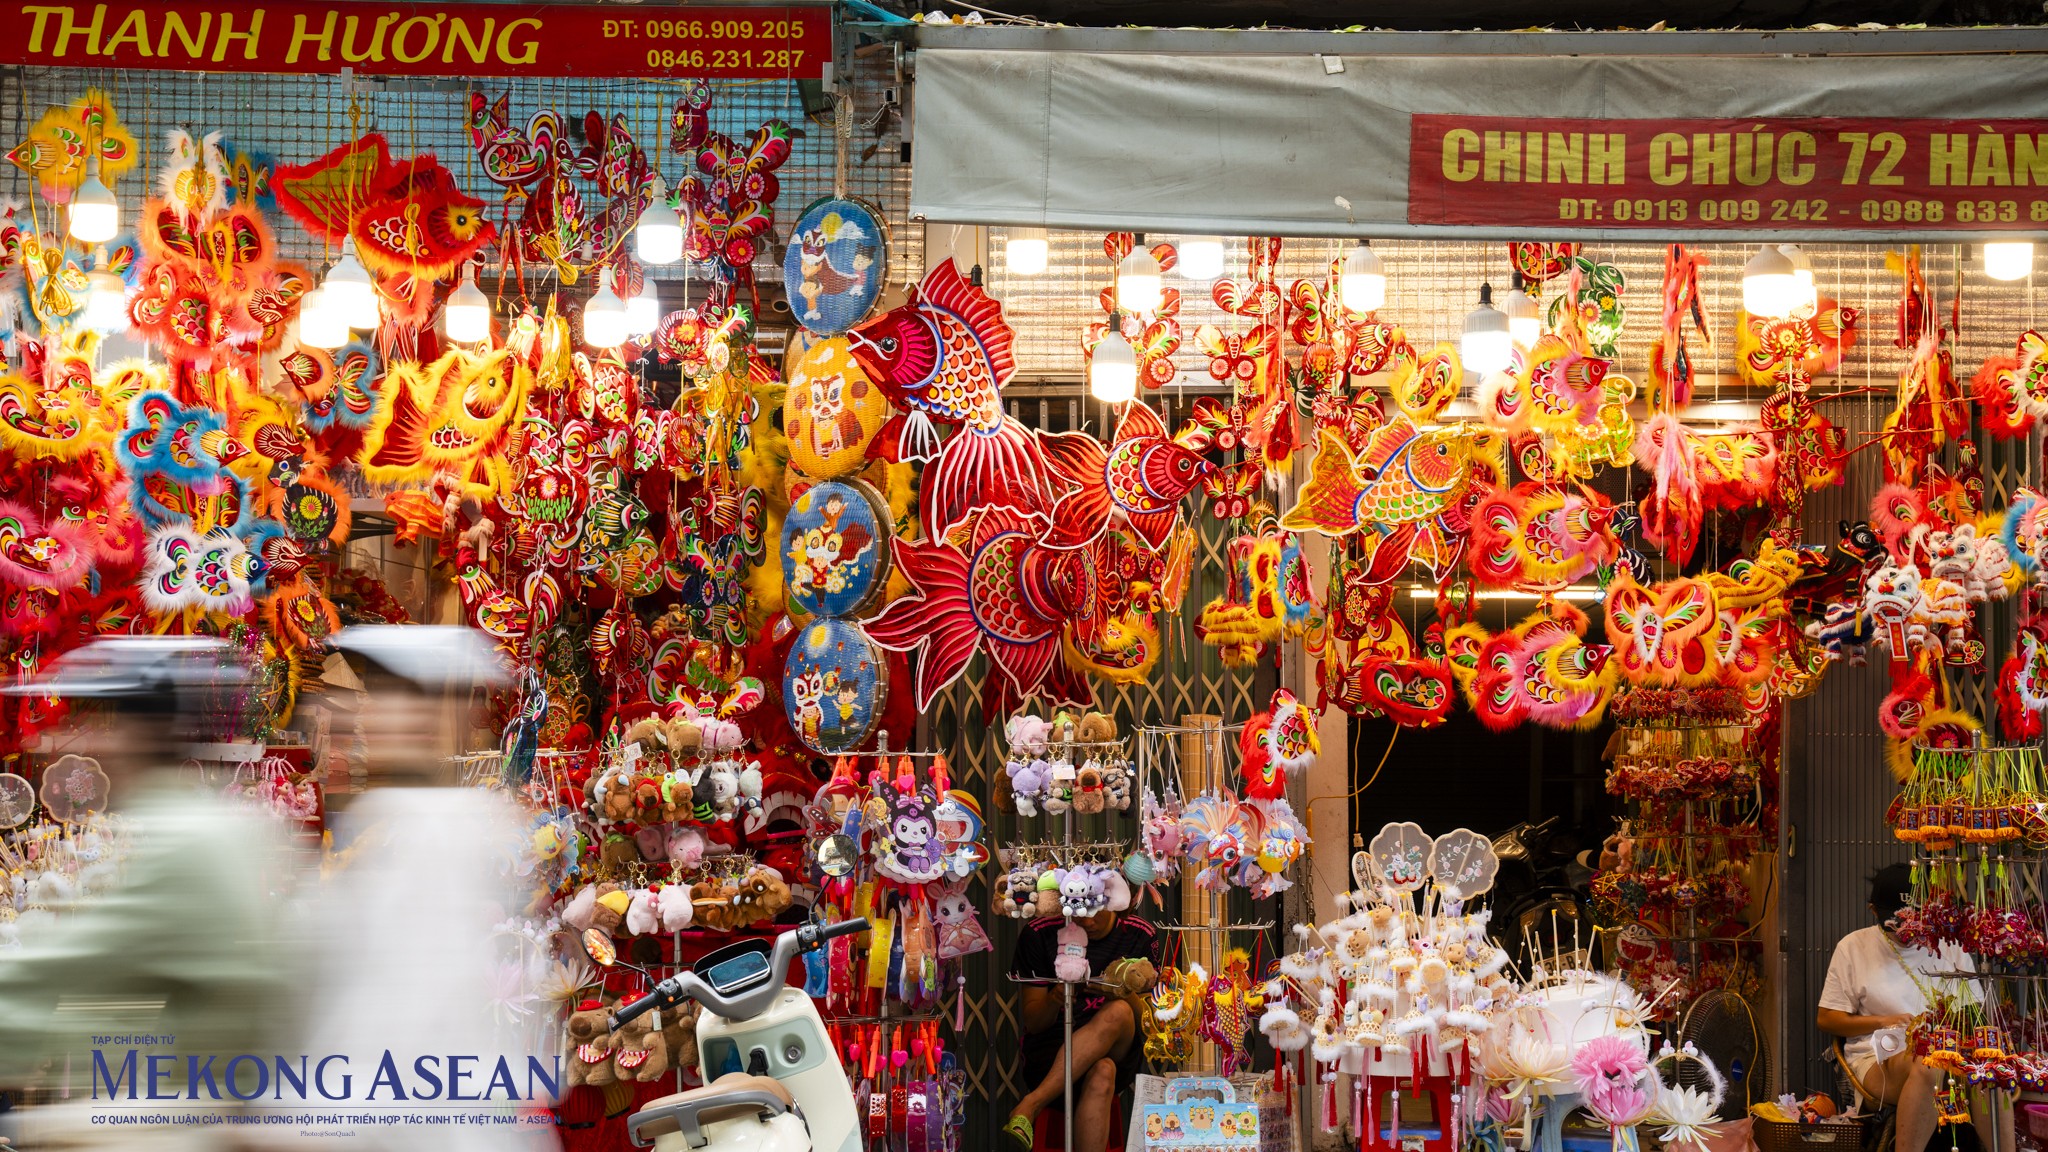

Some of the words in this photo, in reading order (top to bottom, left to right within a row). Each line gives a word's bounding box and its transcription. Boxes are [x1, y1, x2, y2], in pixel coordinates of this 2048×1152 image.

[21, 5, 264, 60] THANH
[285, 12, 543, 65] HƯƠNG
[602, 21, 638, 38] ĐT:
[646, 20, 804, 39] 0966.909.205
[646, 50, 804, 68] 0846.231.287
[1442, 129, 1626, 185] CHINH
[1648, 124, 1816, 186] CHÚC
[1839, 132, 1907, 186] 72
[1929, 125, 2048, 186] HÀN
[1559, 198, 1603, 221] ĐT:
[1613, 199, 1688, 221] 0913
[1699, 199, 1760, 222] 009
[1771, 199, 1828, 221] 242
[1861, 200, 1944, 222] 0988
[1956, 200, 2018, 223] 833
